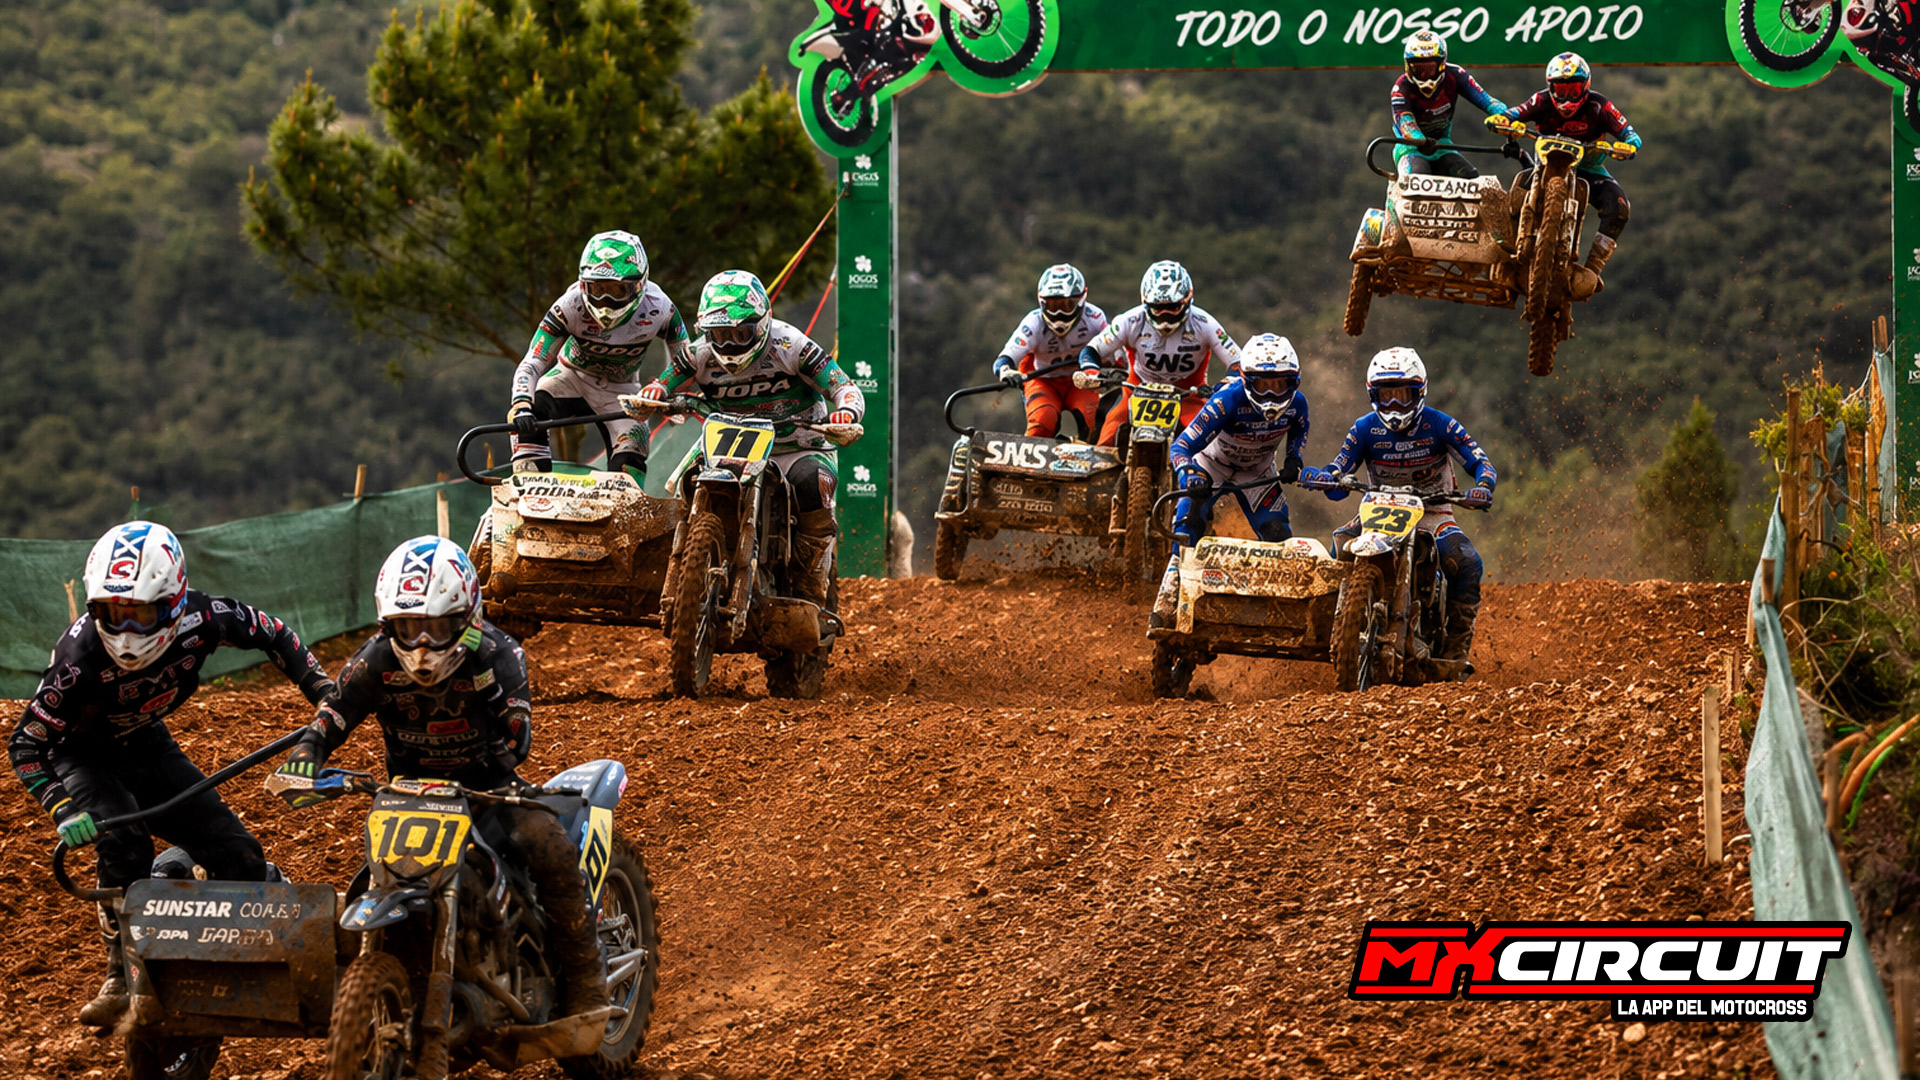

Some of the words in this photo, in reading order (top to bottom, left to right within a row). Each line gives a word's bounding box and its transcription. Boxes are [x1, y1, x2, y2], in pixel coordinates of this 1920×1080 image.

[1175, 9, 1281, 47] TODO
[1299, 9, 1328, 45] O
[1343, 6, 1490, 44] NOSSO
[1505, 4, 1643, 42] APOIO
[712, 378, 791, 399] JOPA
[1134, 399, 1176, 425] 194
[712, 427, 760, 458] 11
[1363, 506, 1412, 533] 23
[377, 816, 460, 861] 101
[143, 900, 233, 918] SUNSTAR
